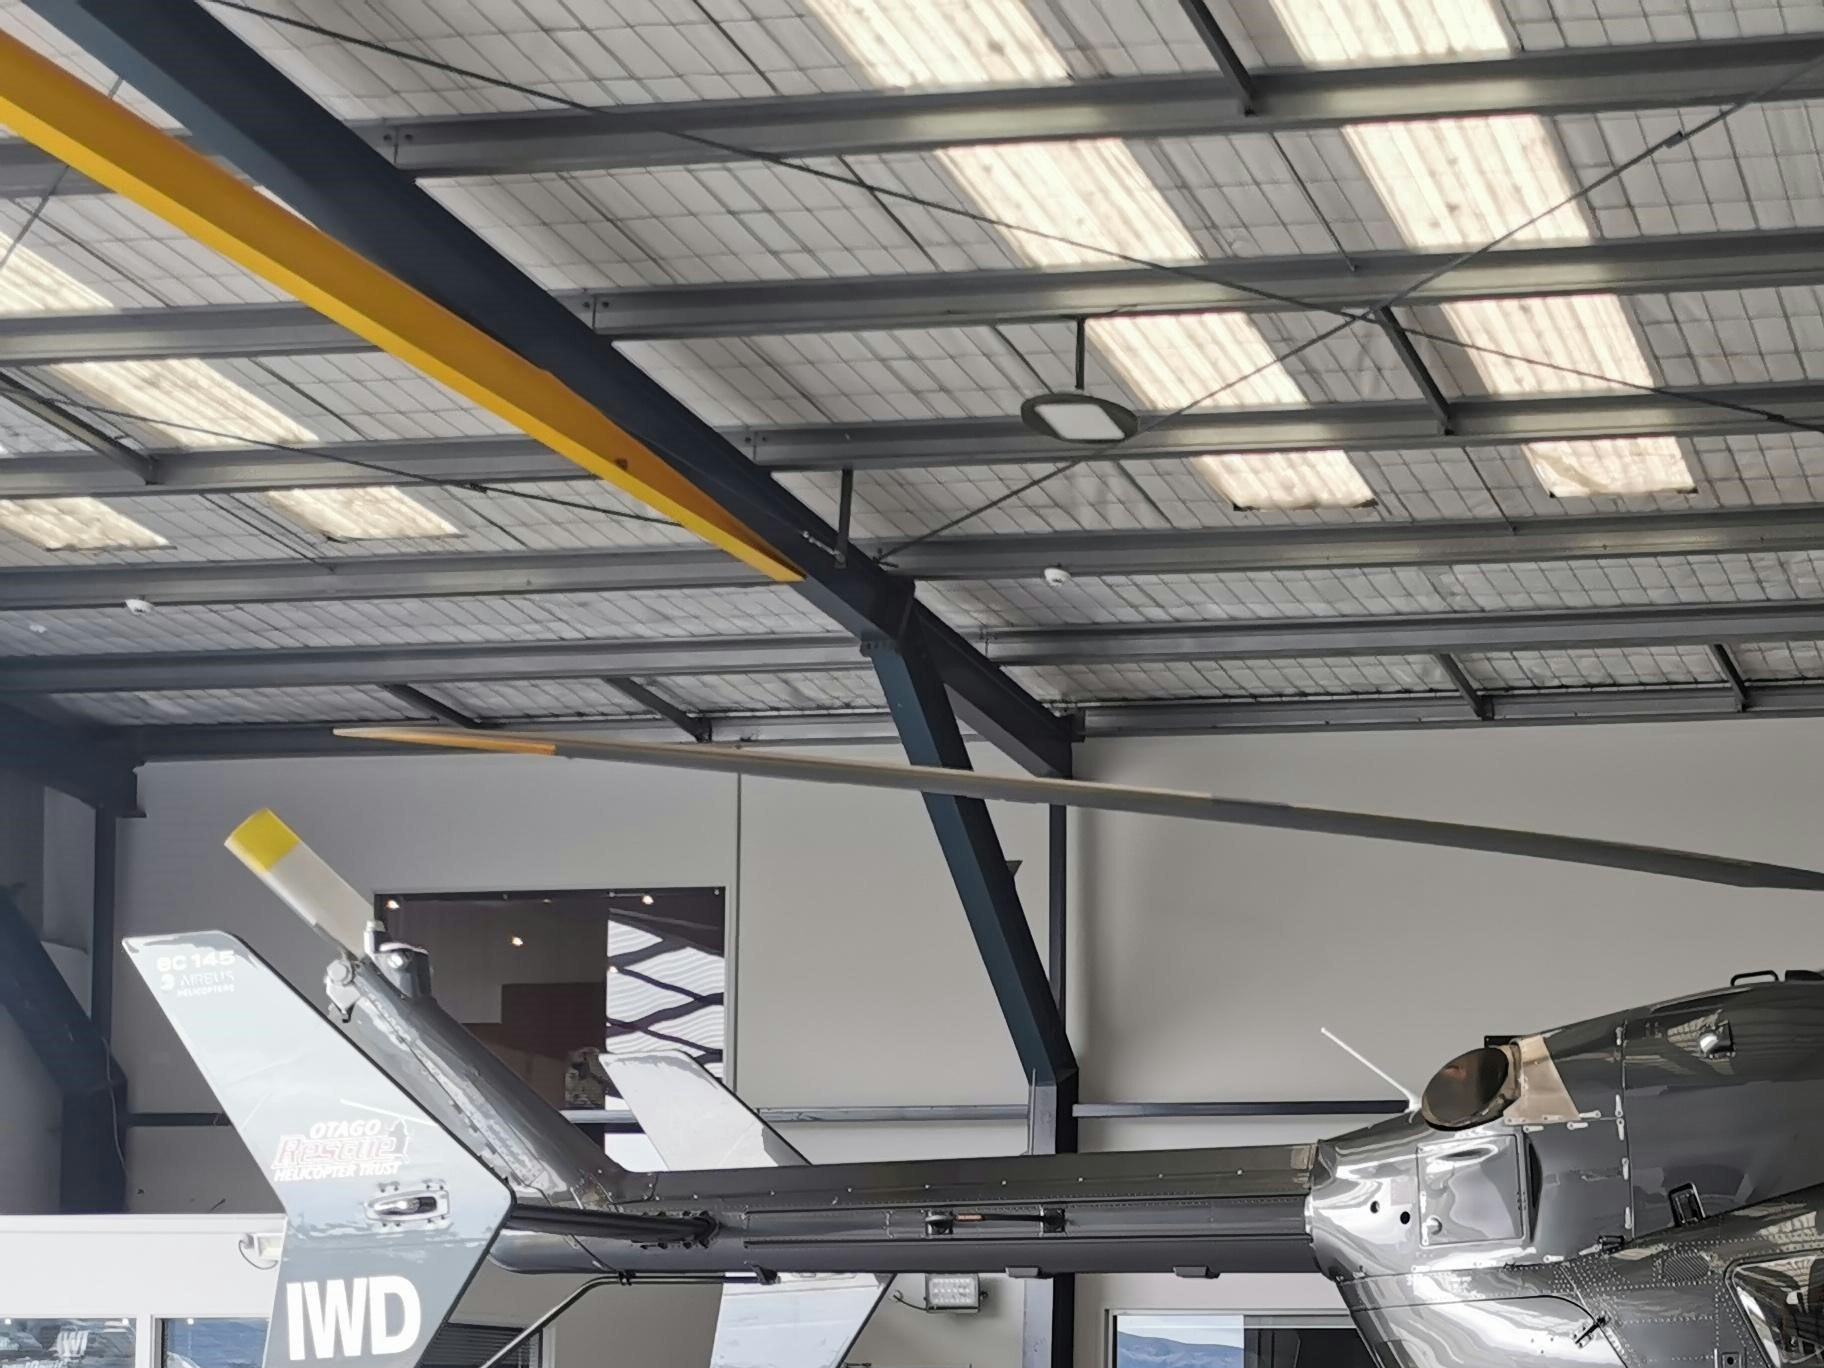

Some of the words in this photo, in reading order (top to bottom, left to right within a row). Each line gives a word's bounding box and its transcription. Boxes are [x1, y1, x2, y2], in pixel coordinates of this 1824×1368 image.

[191, 948, 236, 968] 145
[179, 970, 235, 987] AIRBUS
[309, 1119, 382, 1139] OTAGO
[273, 1164, 356, 1182] HELICOPTER
[359, 1161, 401, 1178] TRUST
[286, 1275, 421, 1361] IWD
